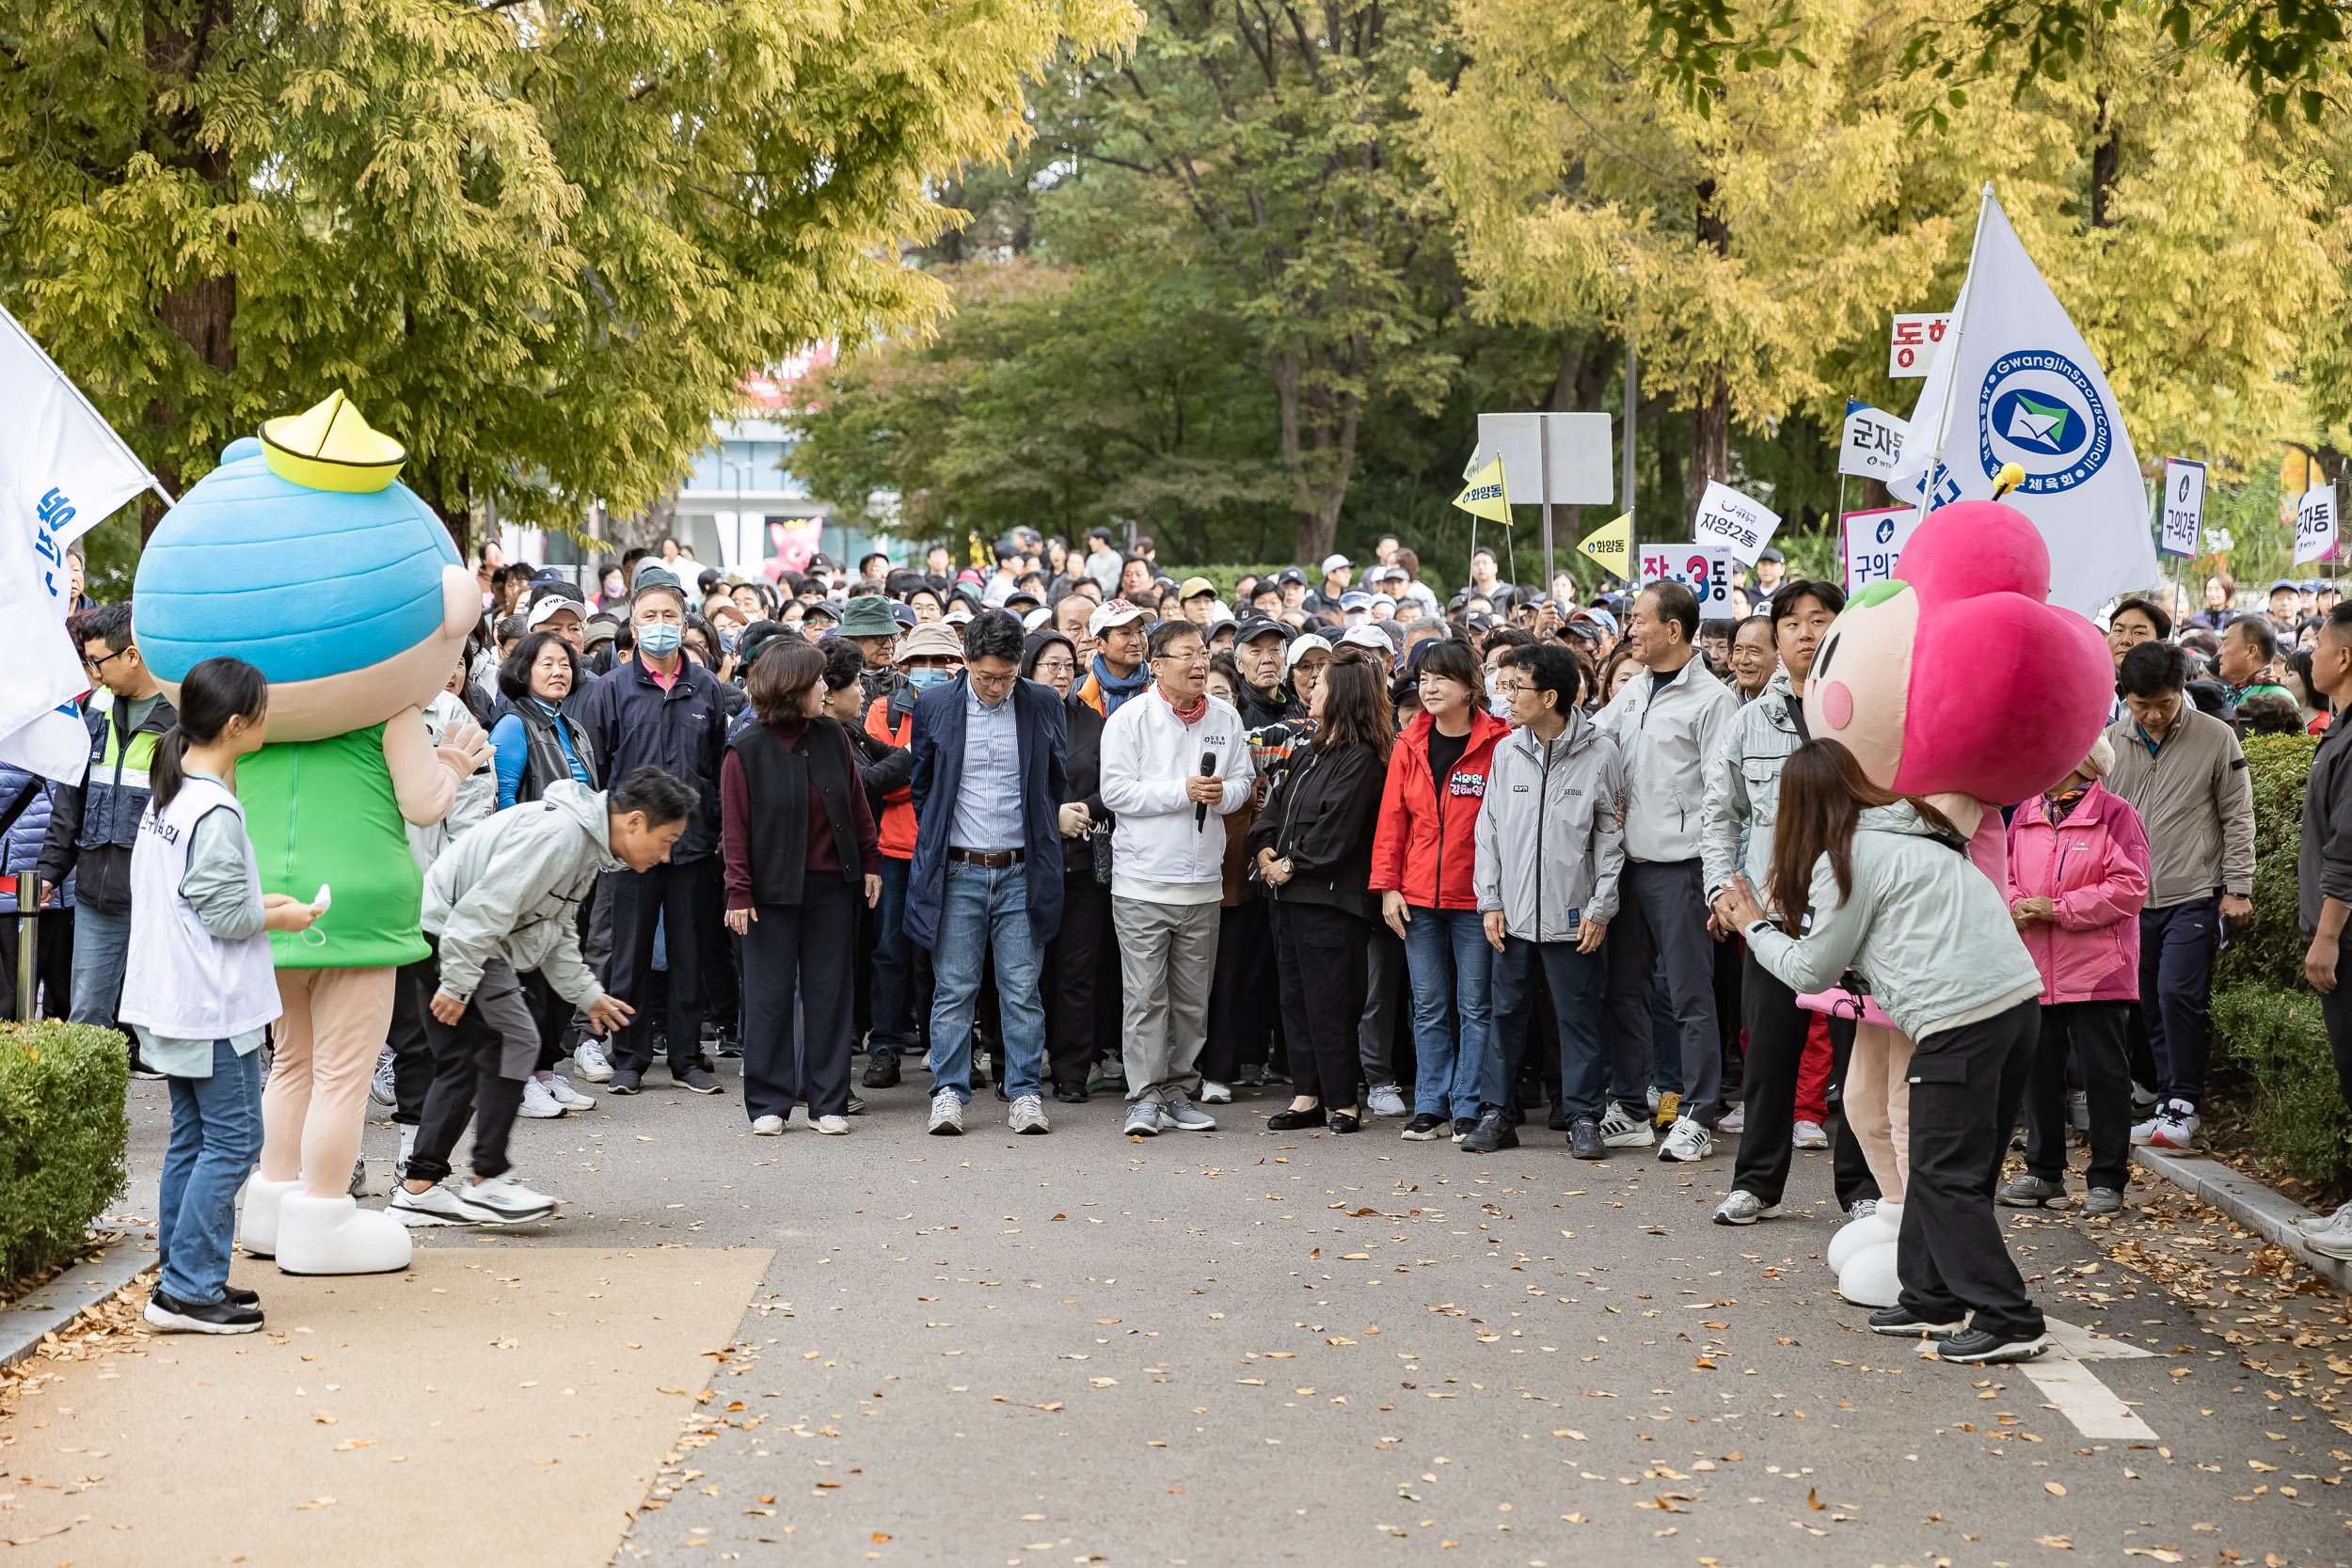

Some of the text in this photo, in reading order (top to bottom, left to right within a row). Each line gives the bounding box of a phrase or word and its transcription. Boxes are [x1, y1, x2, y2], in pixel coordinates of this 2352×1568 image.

[1471, 483, 1502, 500] 화양동
[1700, 513, 1758, 547] 자양2동
[2167, 509, 2195, 546] 구의2동
[1597, 539, 1624, 553] 화양동
[1644, 554, 1727, 603] 자3동
[1563, 788, 1582, 797] SEOUL
